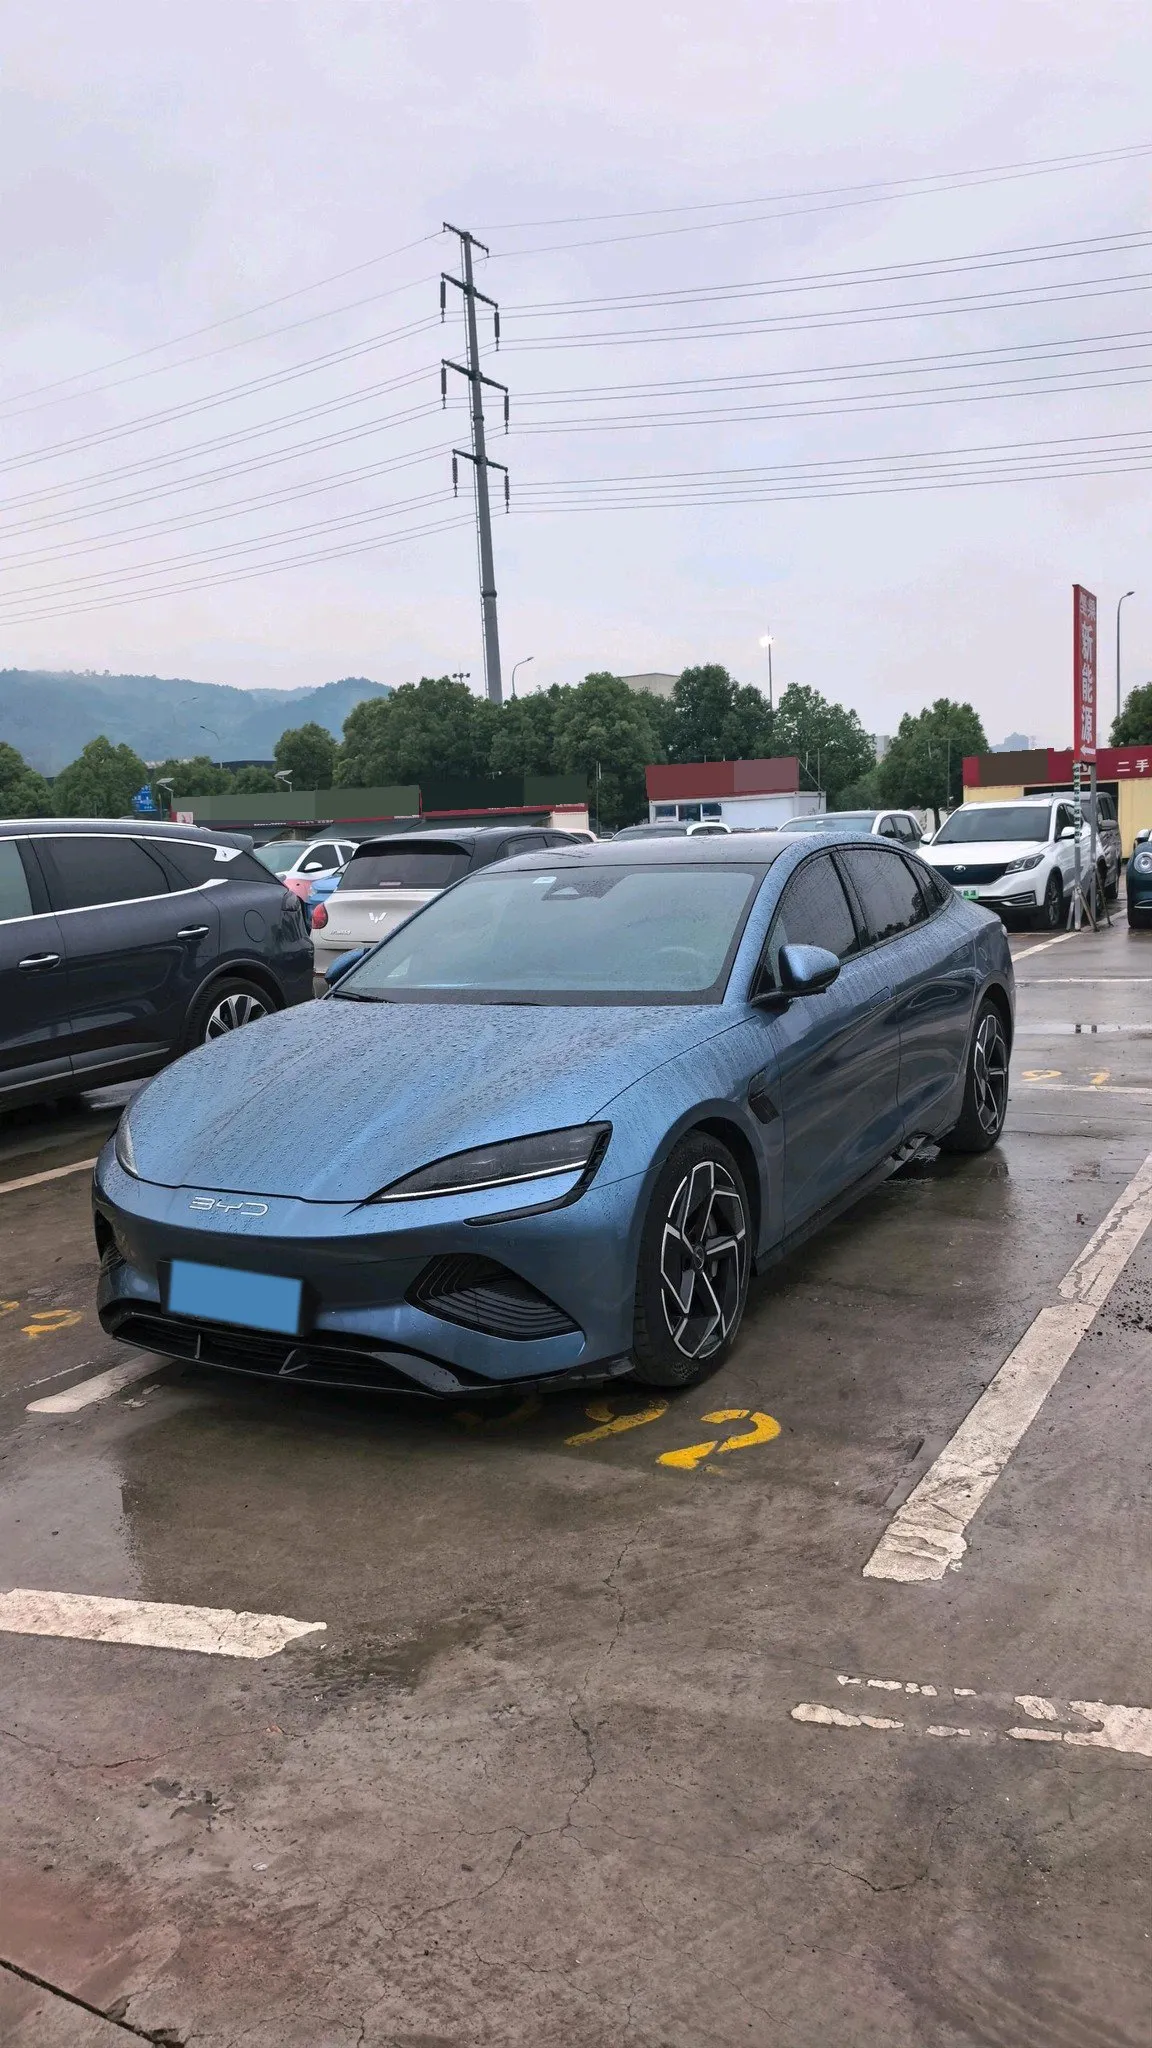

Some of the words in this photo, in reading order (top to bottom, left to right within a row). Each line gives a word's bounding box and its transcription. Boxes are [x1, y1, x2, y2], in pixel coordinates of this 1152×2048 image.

[1081, 621, 1093, 744] 新能源
[1116, 759, 1150, 773] 二手
[188, 1196, 269, 1216] BYD
